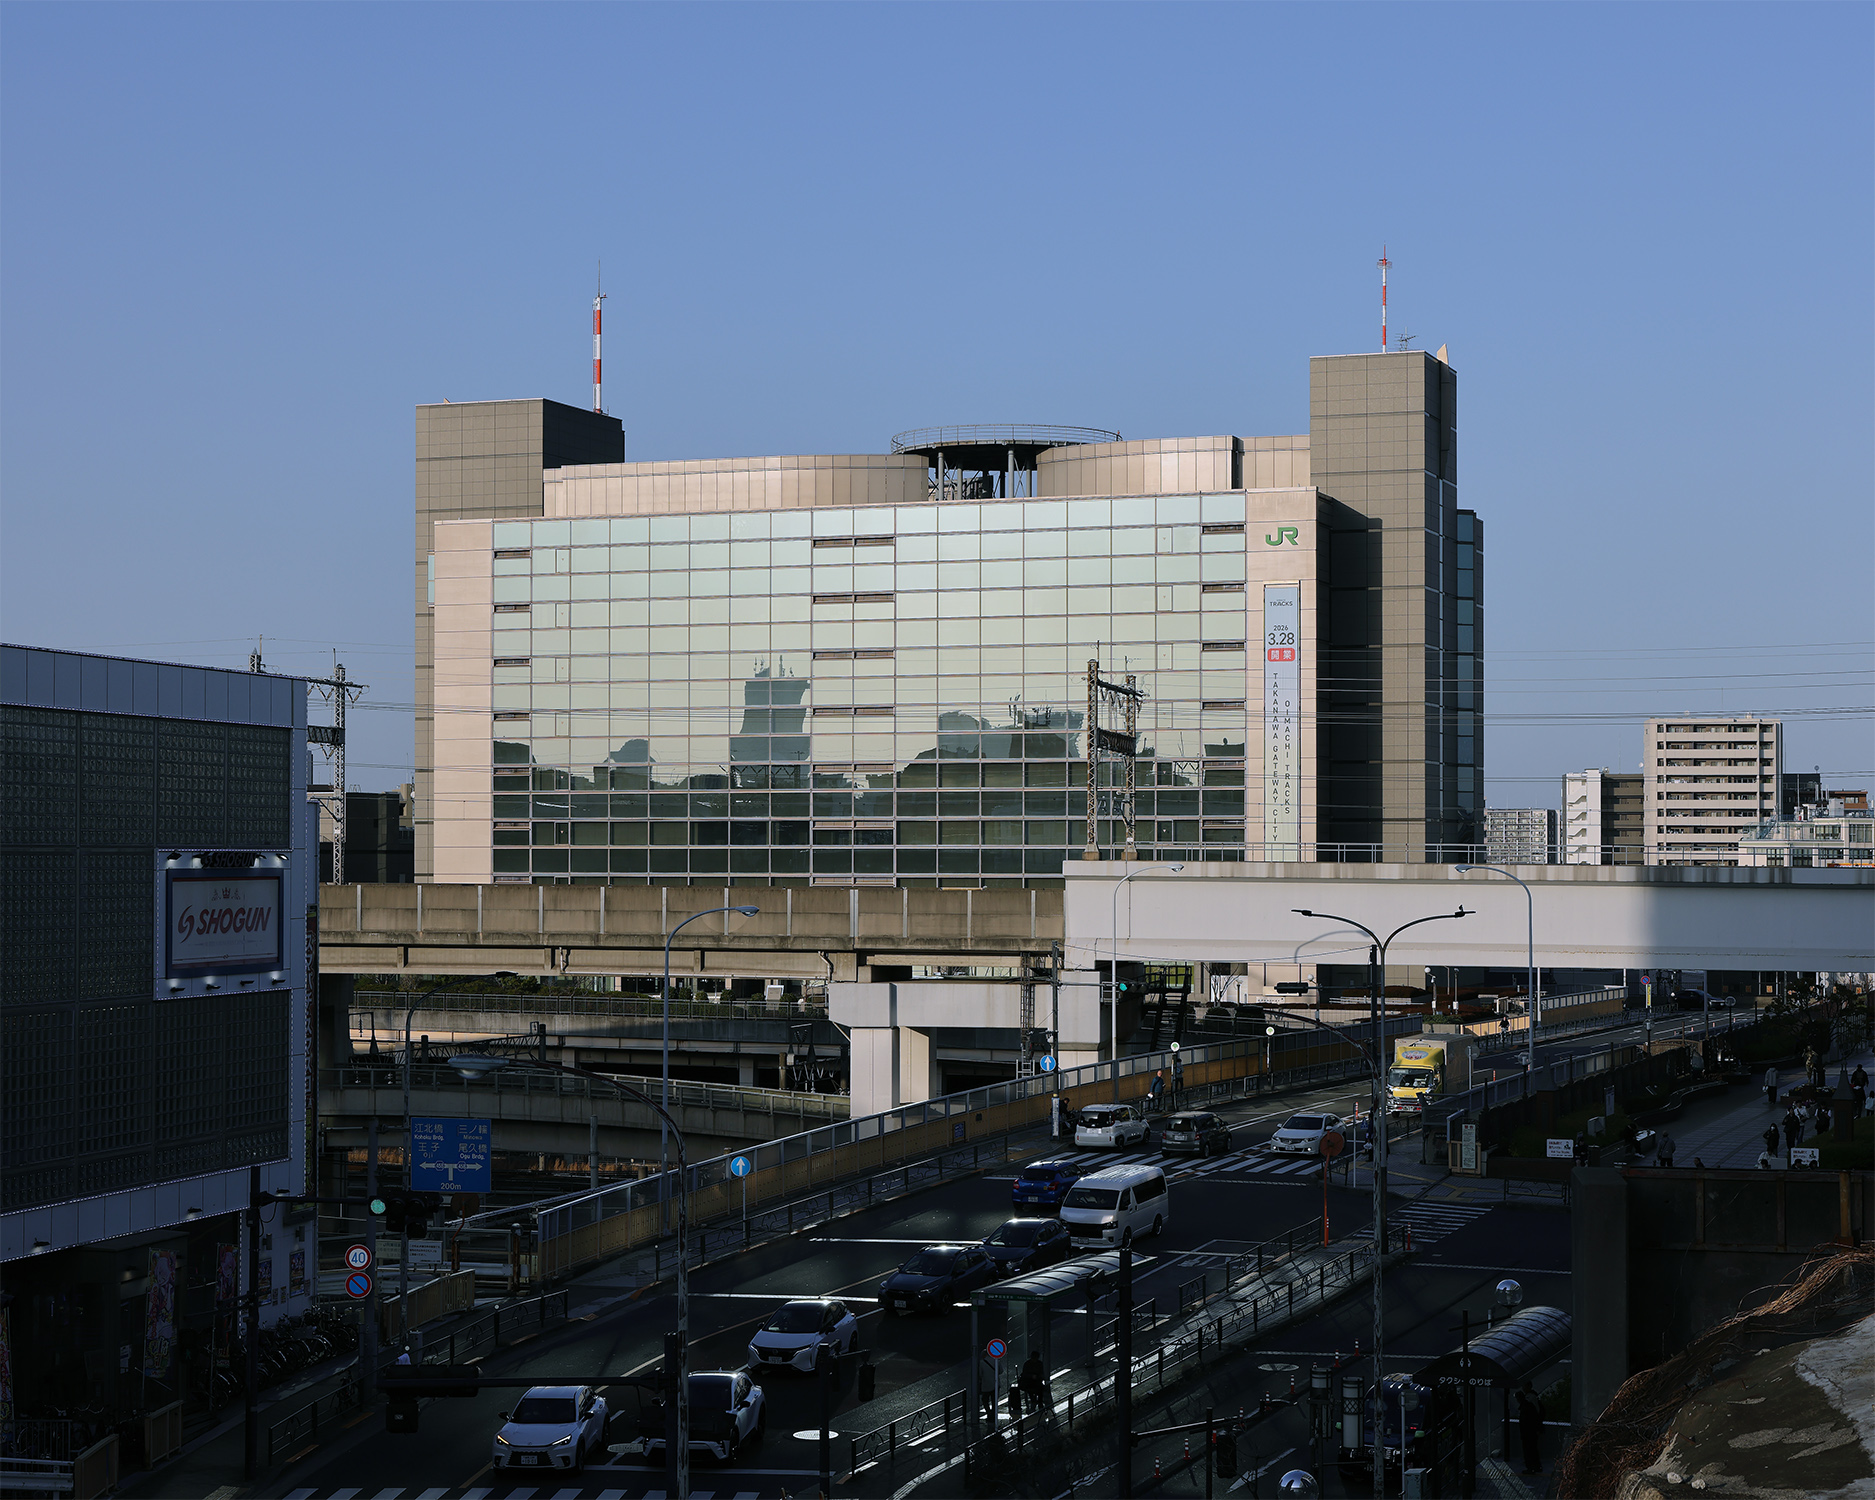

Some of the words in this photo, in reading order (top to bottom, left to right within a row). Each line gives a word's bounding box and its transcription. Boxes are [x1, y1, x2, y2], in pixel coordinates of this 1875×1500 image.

[1265, 526, 1299, 546] JR
[1268, 632, 1295, 646] 3.28
[1270, 649, 1293, 660] 開業
[213, 851, 257, 867] SHOGUN
[196, 906, 272, 936] SHOGUN
[414, 1123, 444, 1134] 江北橋
[458, 1124, 488, 1135] 三ノ輪
[418, 1142, 440, 1152] 王子
[458, 1143, 488, 1153] 尾久橋
[440, 1182, 462, 1190] 200m
[351, 1252, 366, 1264] 40
